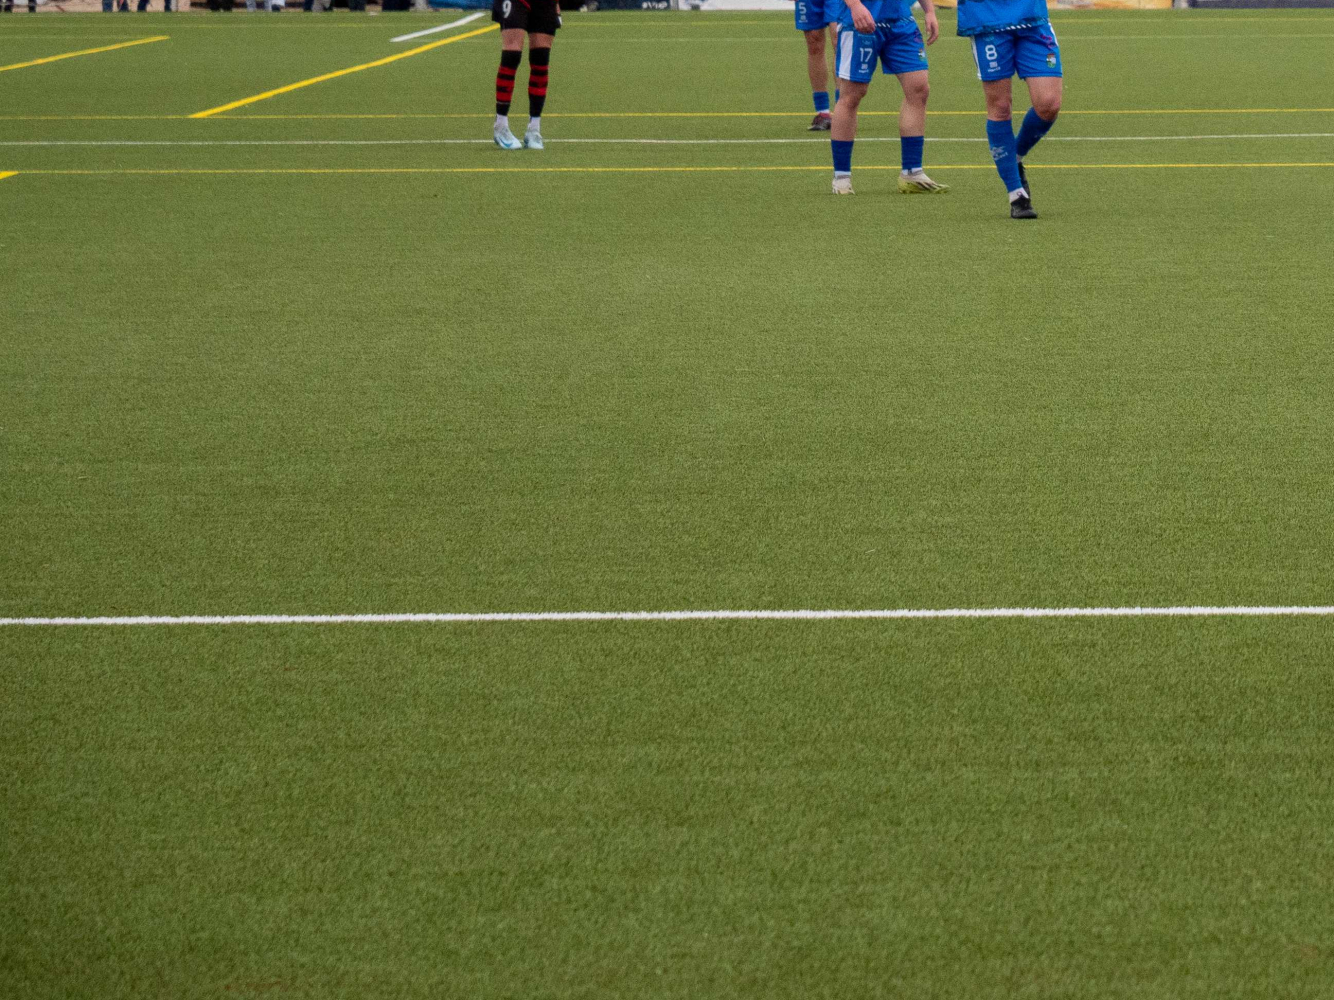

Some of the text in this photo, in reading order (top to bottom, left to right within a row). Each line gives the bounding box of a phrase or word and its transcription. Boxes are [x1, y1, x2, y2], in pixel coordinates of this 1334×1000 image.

[502, 0, 512, 19] 9
[798, 2, 807, 14] 5
[859, 47, 873, 63] 17
[984, 44, 998, 61] 8
